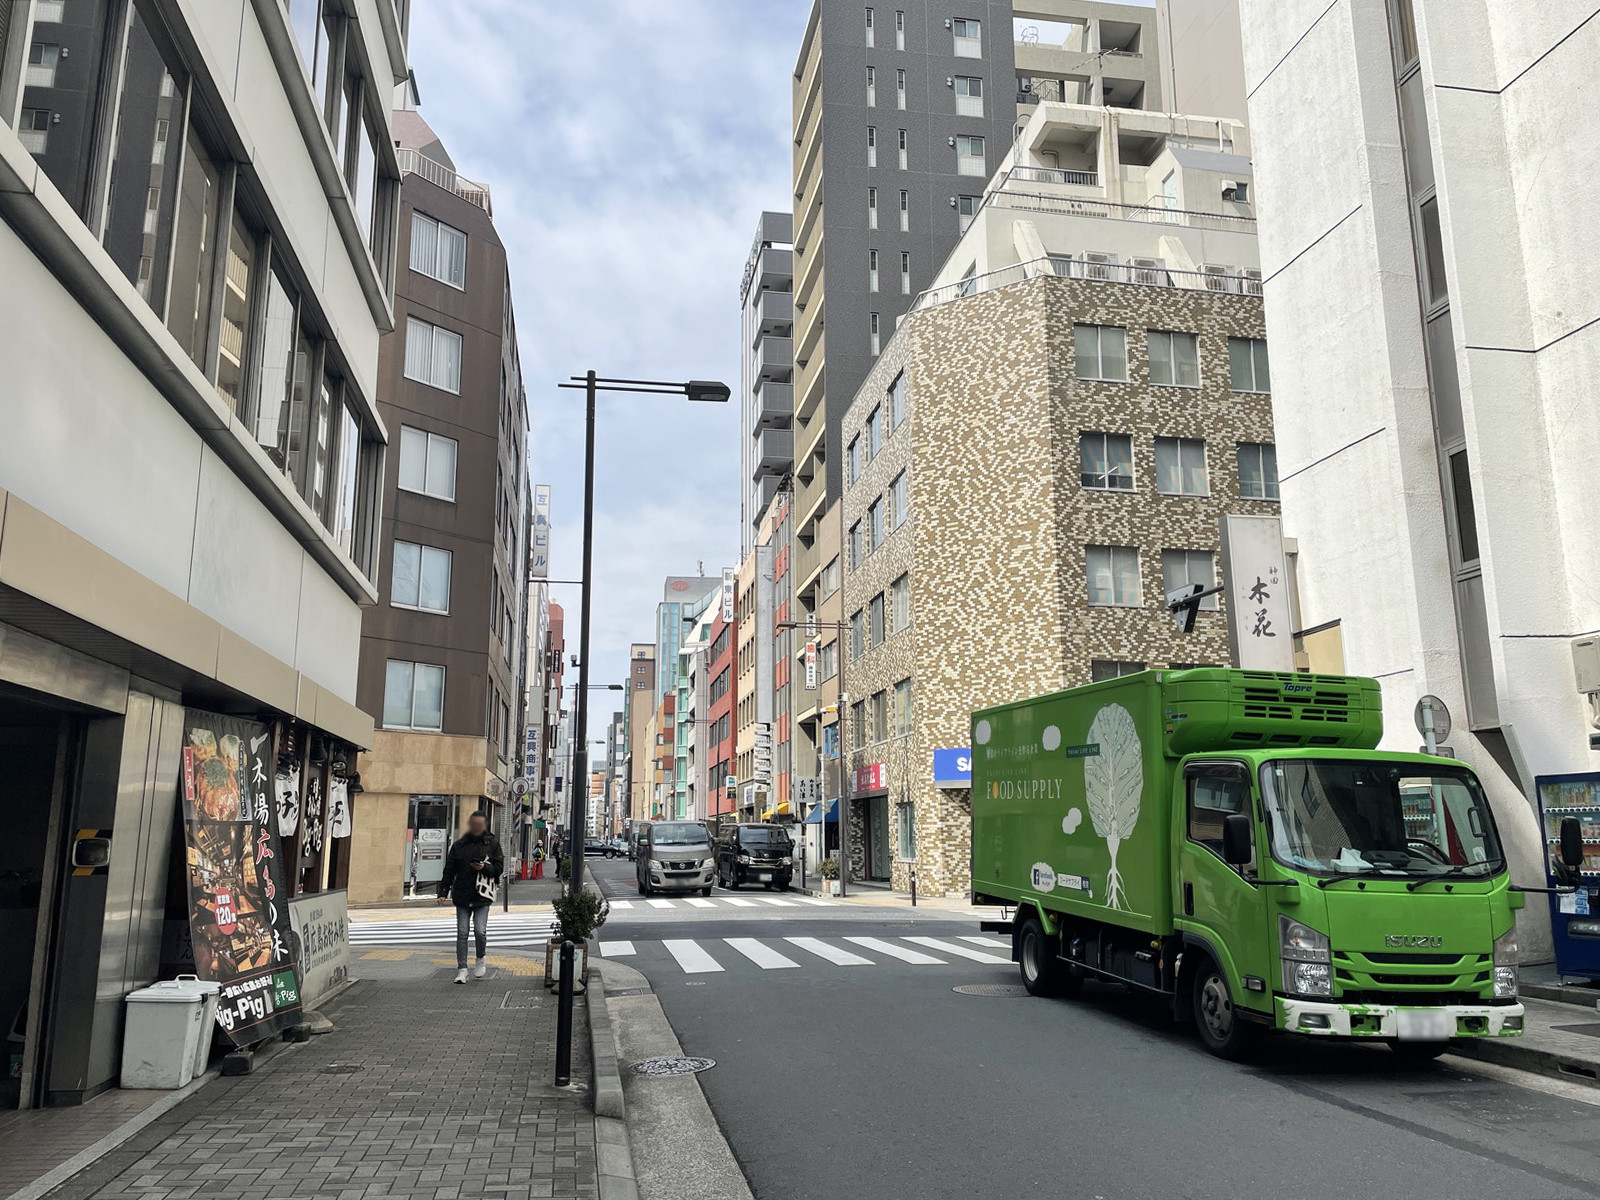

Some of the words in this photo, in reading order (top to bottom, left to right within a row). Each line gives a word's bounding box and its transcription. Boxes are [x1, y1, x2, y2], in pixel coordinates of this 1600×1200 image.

[724, 571, 732, 619] 新東ビル
[1248, 576, 1277, 637] 木花
[1284, 682, 1313, 692] Topre
[525, 730, 537, 776] 互興商事
[956, 757, 972, 772] S
[1017, 779, 1062, 799] SUPPLY
[1385, 934, 1442, 948] ISUZU
